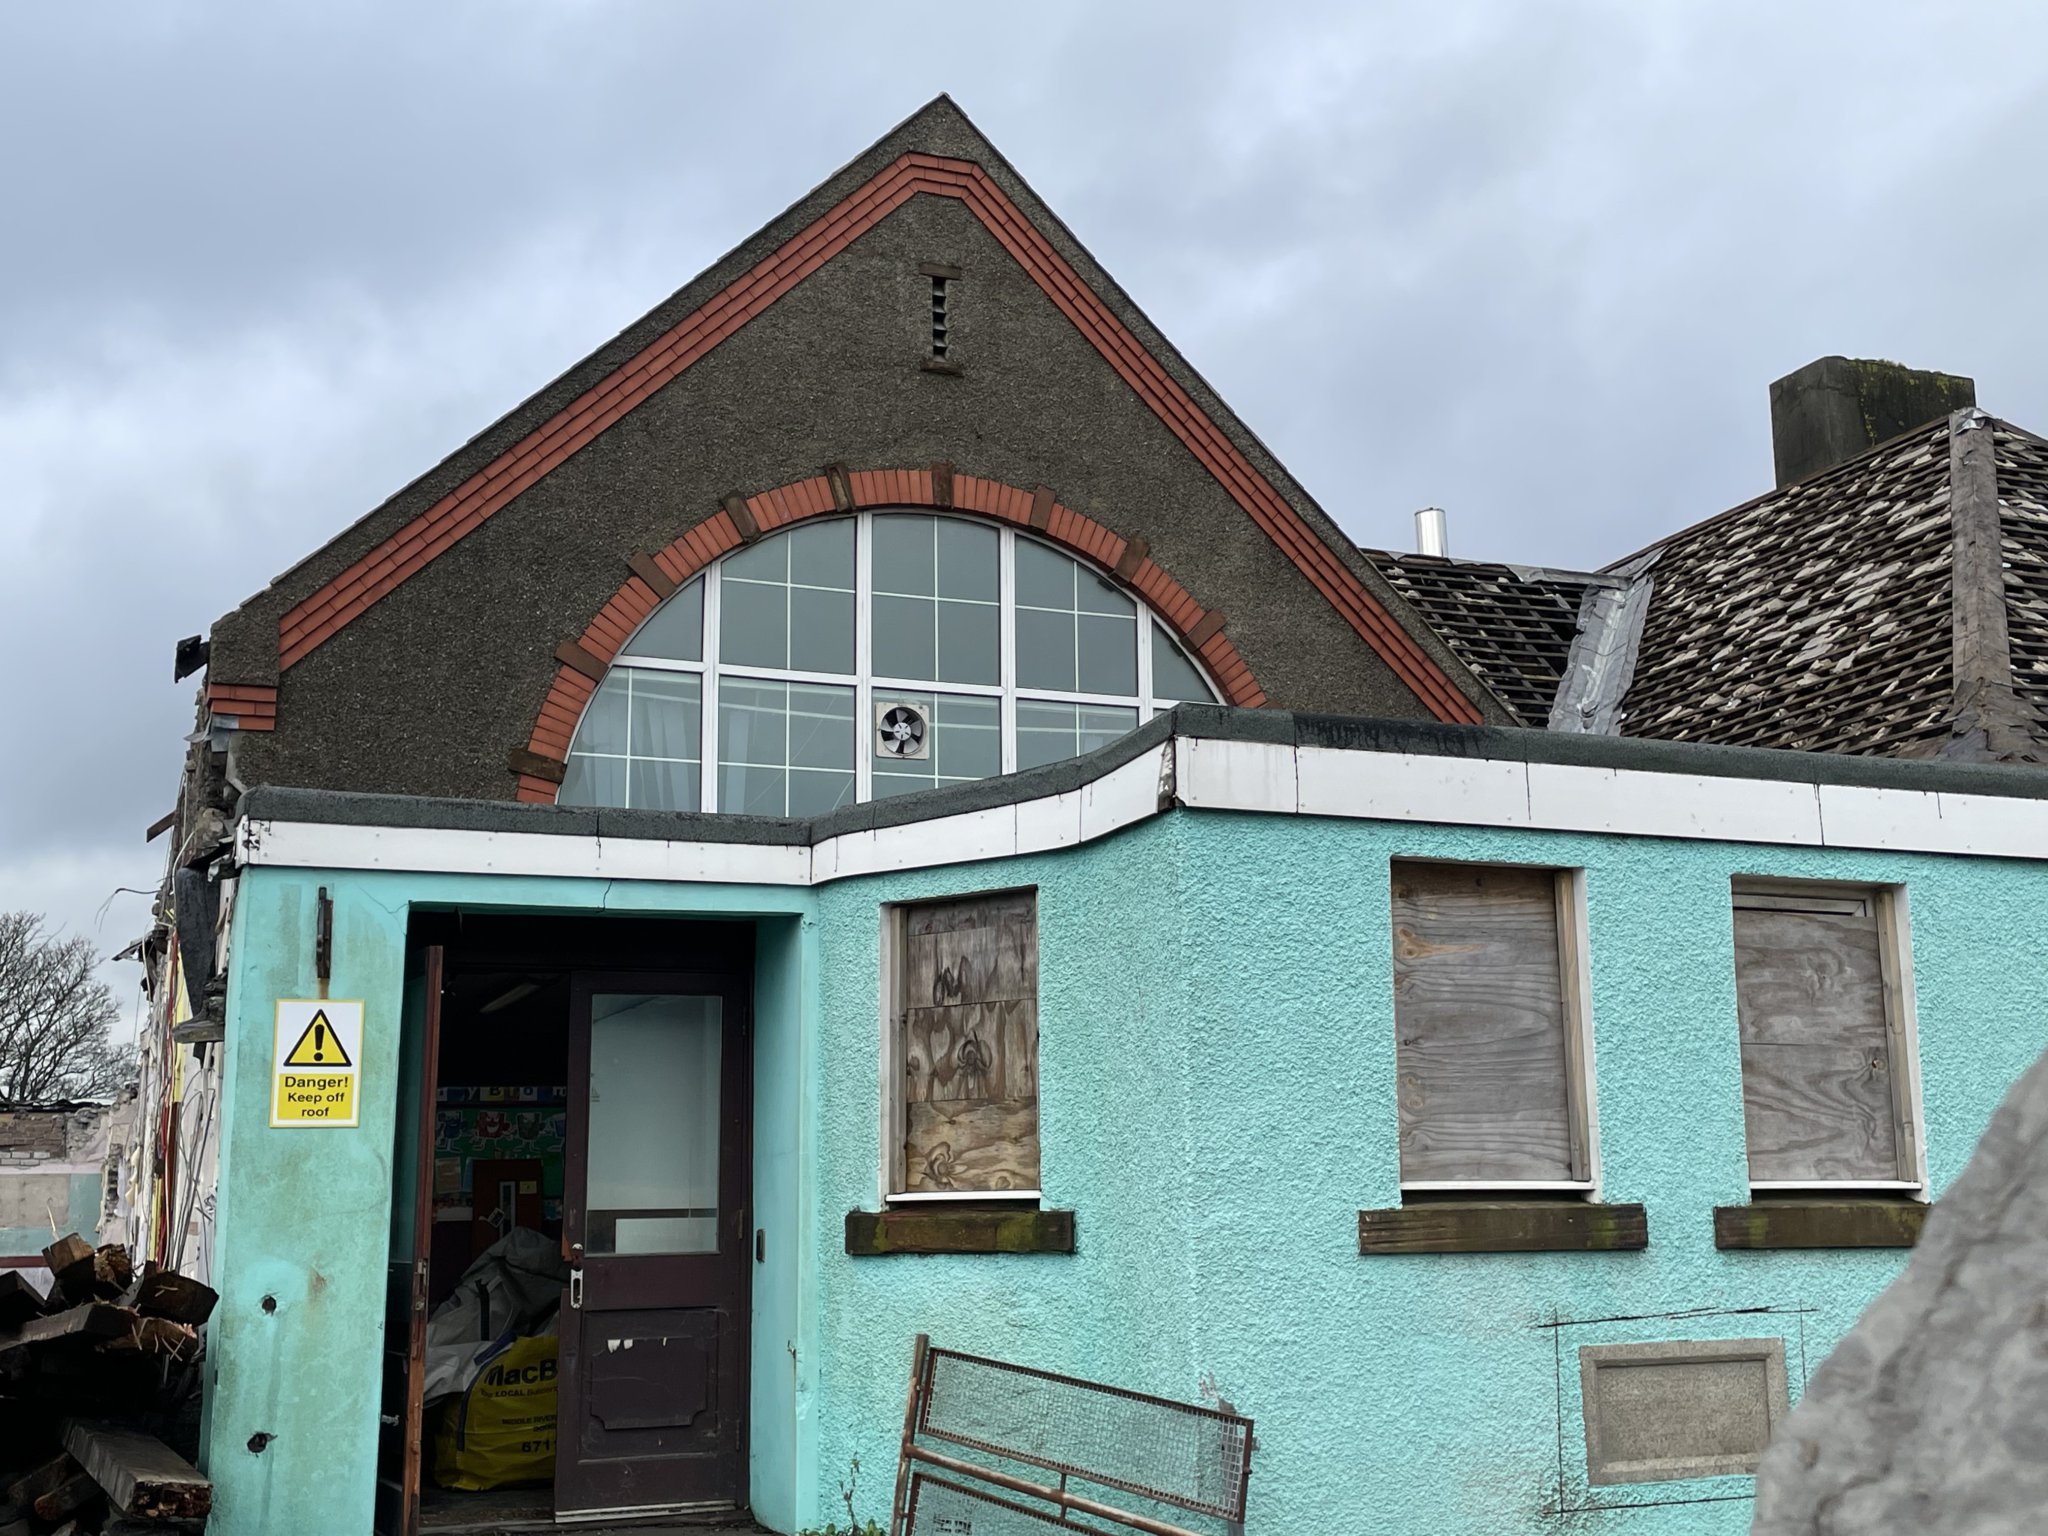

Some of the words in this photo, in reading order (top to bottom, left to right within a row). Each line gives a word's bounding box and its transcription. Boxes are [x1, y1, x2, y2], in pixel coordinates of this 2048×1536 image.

[284, 1076, 349, 1091] Danger!
[287, 1092, 322, 1104] Keep
[326, 1092, 345, 1103] off
[301, 1106, 330, 1117] roof
[495, 1388, 524, 1398] LOCAL
[521, 1438, 557, 1453] 671
